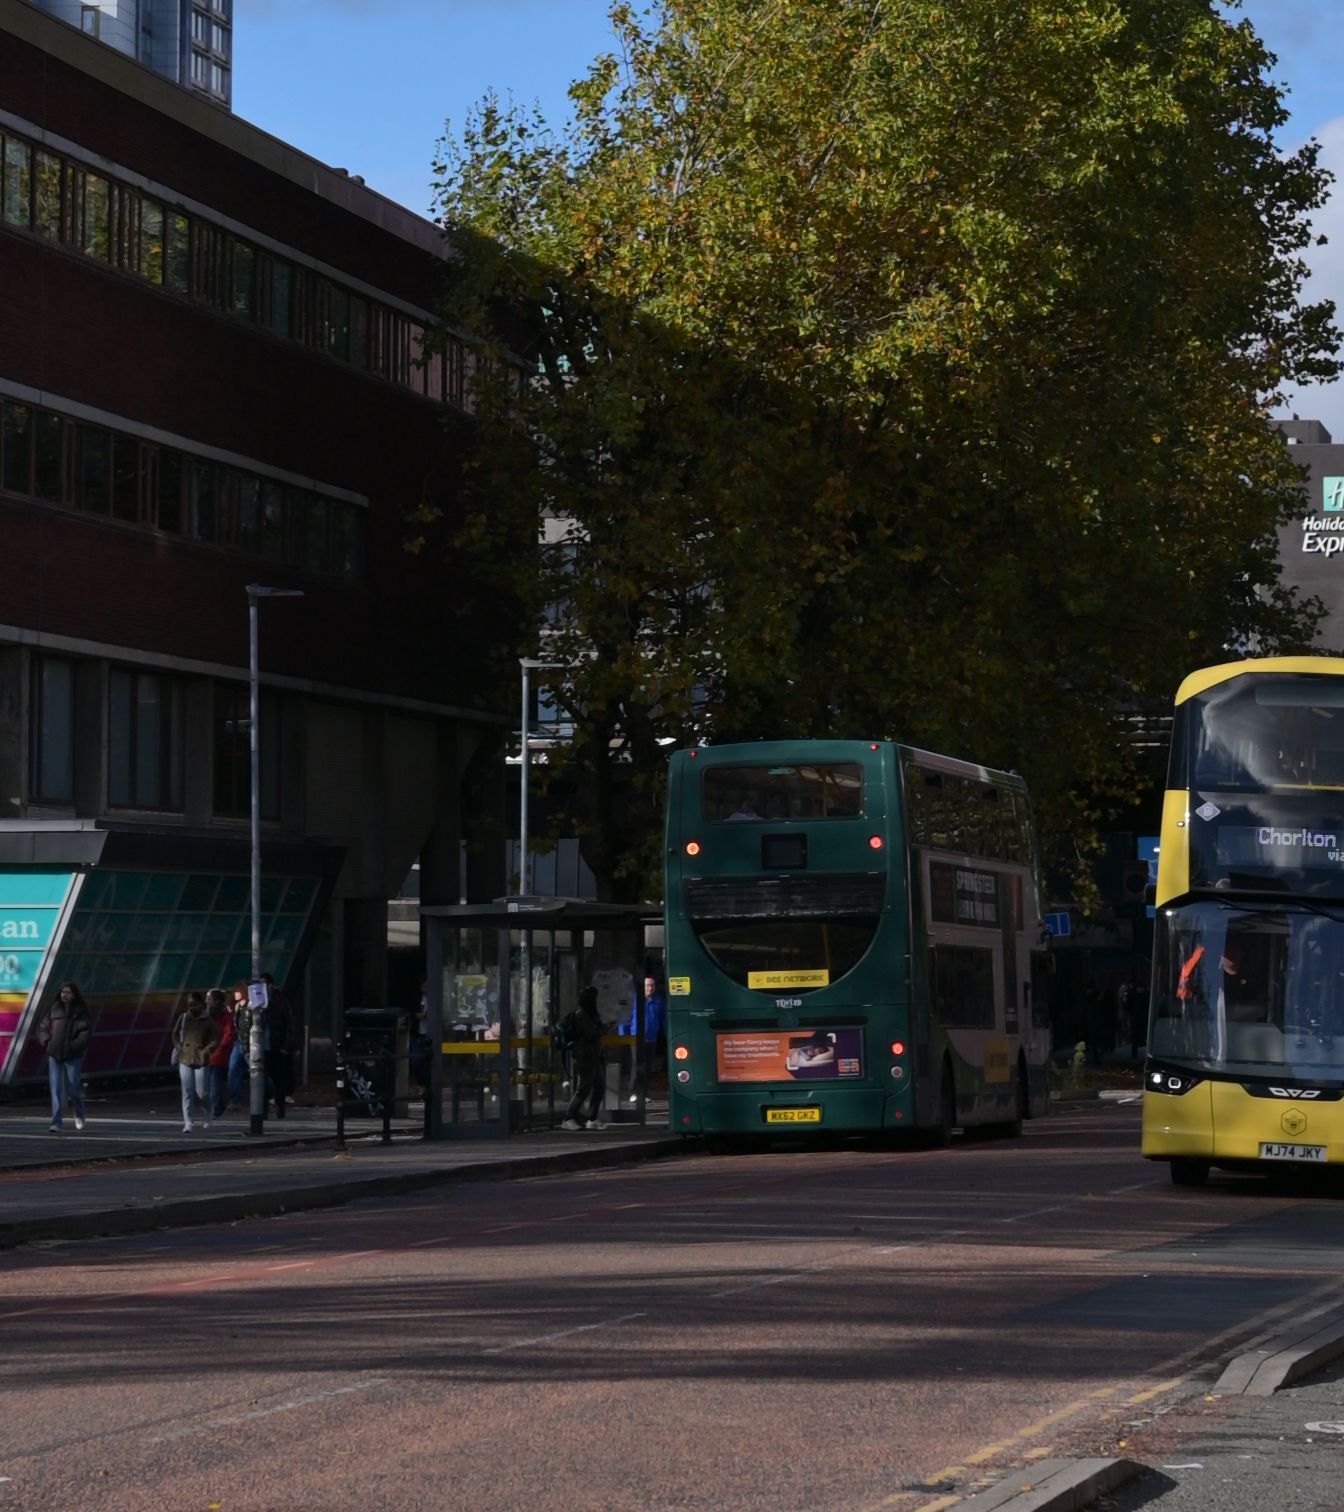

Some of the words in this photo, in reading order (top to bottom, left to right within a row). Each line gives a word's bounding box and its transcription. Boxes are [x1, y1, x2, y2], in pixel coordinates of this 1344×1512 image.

[1258, 826, 1337, 848] Chorlton
[766, 974, 781, 983] BEE
[784, 972, 825, 983] NETWORK
[1265, 1145, 1295, 1158] MJ74
[1299, 1146, 1322, 1158] JKY
